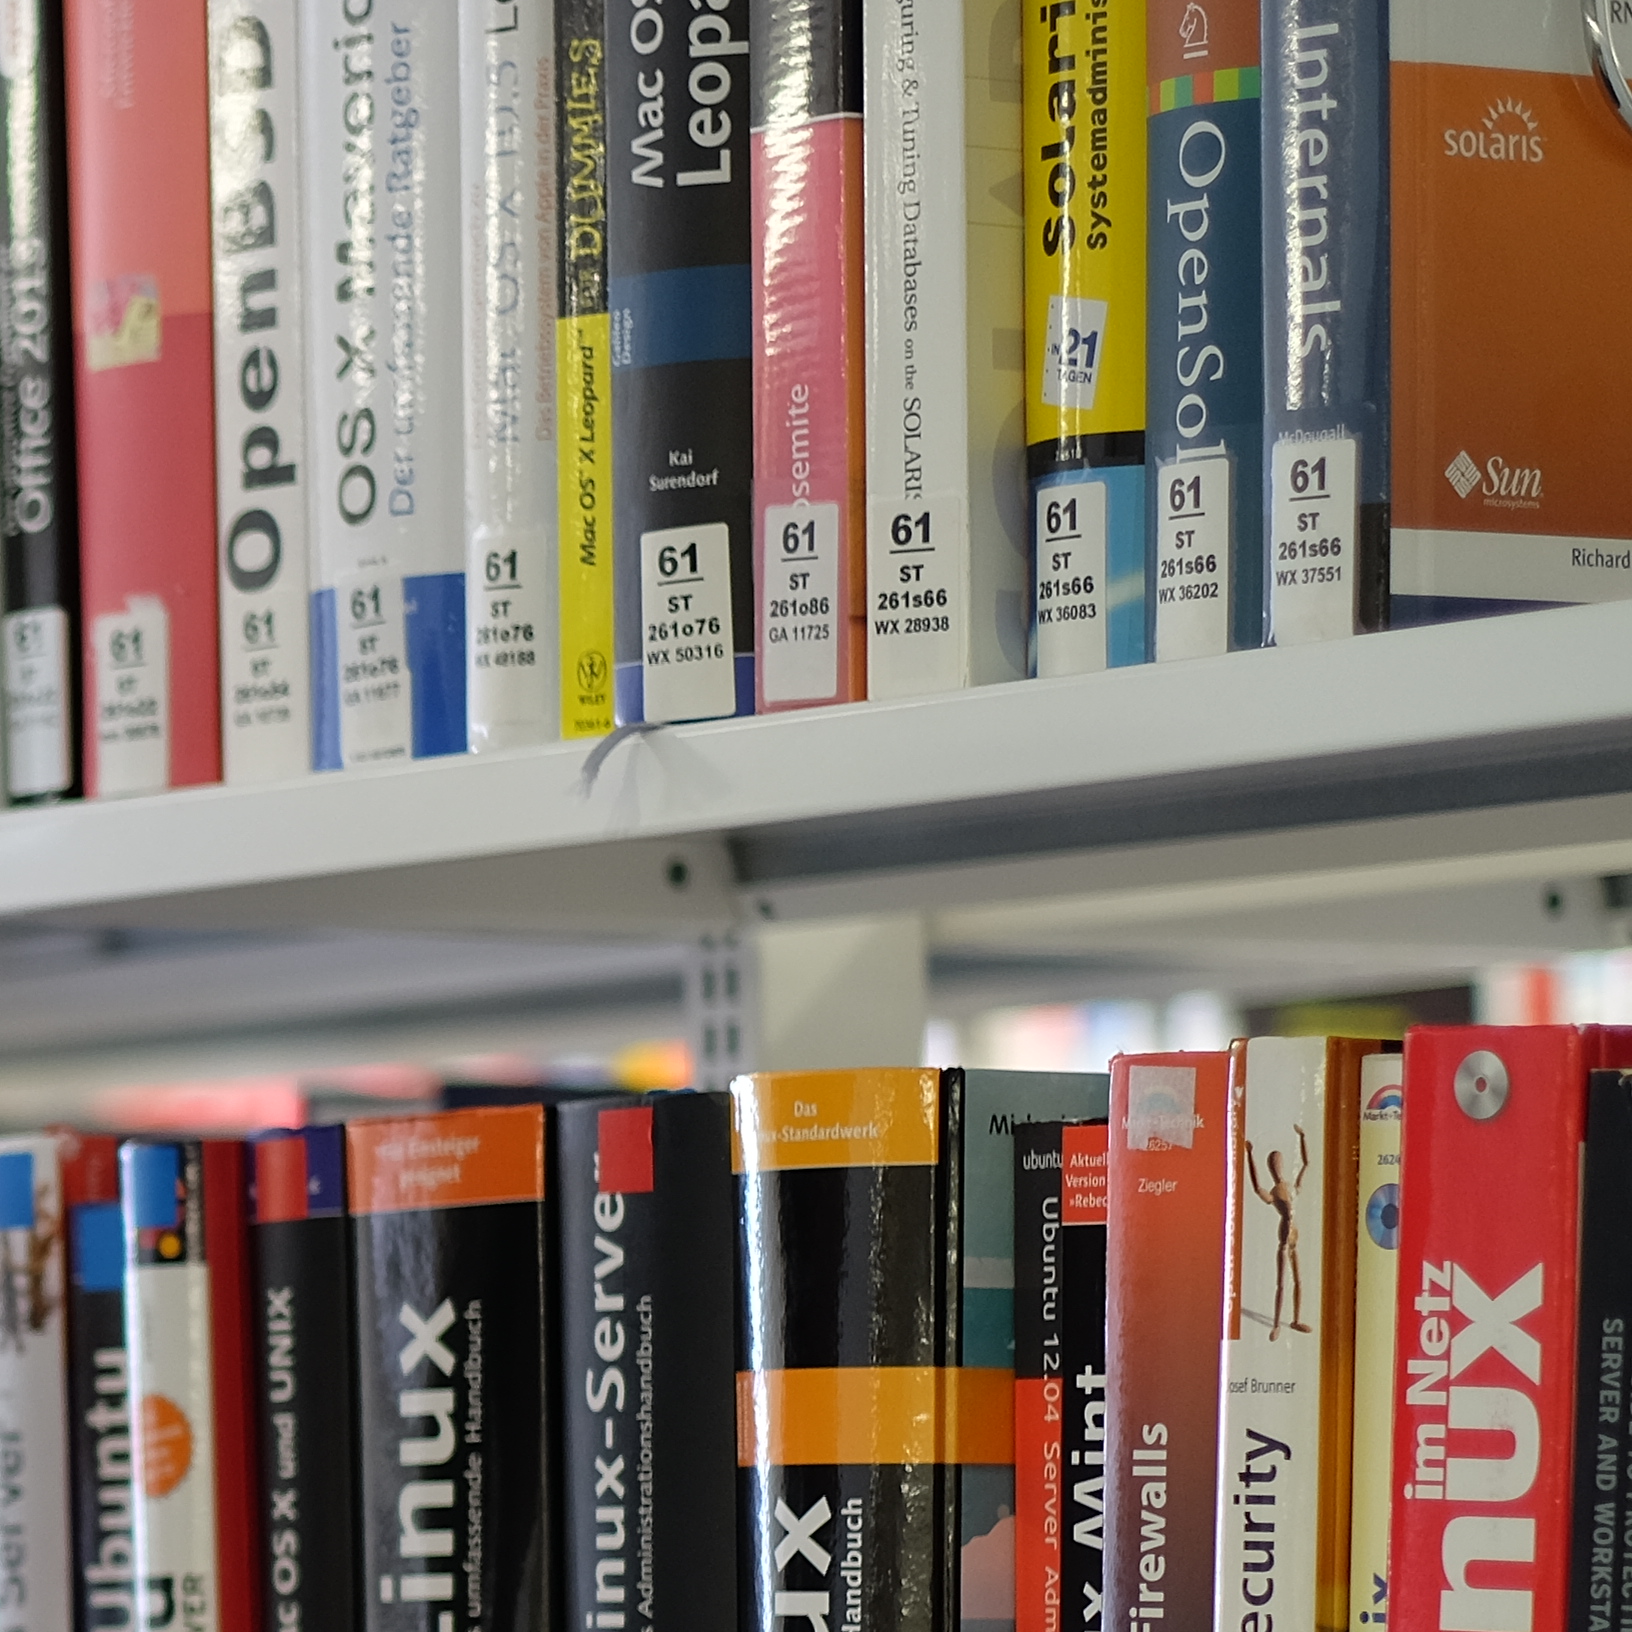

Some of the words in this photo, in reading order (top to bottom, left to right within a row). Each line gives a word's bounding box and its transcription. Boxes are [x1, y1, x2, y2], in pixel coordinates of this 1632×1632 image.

[902, 79, 919, 99] &
[385, 19, 420, 194] Ratgeber
[631, 68, 665, 188] Mac
[896, 107, 921, 196] Tuning
[902, 200, 924, 333] Databases
[904, 338, 915, 361] on
[1057, 327, 1099, 369] 21
[904, 364, 918, 391] the
[337, 407, 377, 526] OS
[668, 448, 694, 467] Kai
[1290, 455, 1328, 494] 61
[387, 452, 416, 518] Der
[648, 467, 720, 492] Surendorf
[1169, 475, 1202, 512] 61
[1482, 455, 1542, 498] Sun
[1046, 497, 1078, 535] 61
[1482, 497, 1541, 511] microsystems
[782, 519, 816, 555] 61
[889, 511, 933, 547] 61
[1296, 512, 1320, 532] ST
[578, 515, 597, 567] Mac
[1174, 530, 1196, 549] ST
[1277, 536, 1342, 562] 261s66
[485, 549, 519, 582] 61
[657, 542, 700, 578] 61
[899, 564, 925, 583] ST
[1051, 552, 1072, 572] ST
[1160, 554, 1217, 579] 261s66
[1570, 547, 1632, 570] Richard
[788, 572, 811, 591] ST
[1038, 576, 1095, 601] 261s66
[1275, 569, 1298, 587] WX
[1302, 566, 1343, 585] 37551
[667, 594, 694, 614] ST
[769, 597, 830, 618] 261o86
[876, 588, 949, 612] 261s66
[1158, 588, 1177, 606] WX
[1178, 582, 1219, 602] 36202
[647, 617, 722, 642] 261o76
[874, 618, 900, 637] WX
[904, 615, 950, 635] 28938
[1037, 608, 1055, 625] WX
[1055, 602, 1097, 622] 36083
[792, 623, 830, 642] 11725
[646, 649, 671, 665] WX
[793, 1100, 817, 1118] Das
[1137, 1178, 1179, 1197] Ziegler
[1040, 1196, 1061, 1322] Ubuntu
[267, 1285, 297, 1404] UNIX
[1405, 1259, 1454, 1408] Netz
[463, 1298, 484, 1444] Handbuch
[1040, 1333, 1062, 1423] 12.04
[1250, 1378, 1297, 1395] Brunner
[1597, 1317, 1625, 1425] SERVER
[272, 1411, 298, 1480] und
[635, 1294, 655, 1619] Administrationshandbuch
[1071, 1364, 1106, 1551] Mint
[1404, 1423, 1447, 1500] im
[1594, 1433, 1620, 1492] AND
[1041, 1440, 1061, 1548] Server
[461, 1450, 484, 1619] umfassende
[271, 1526, 300, 1596] OS
